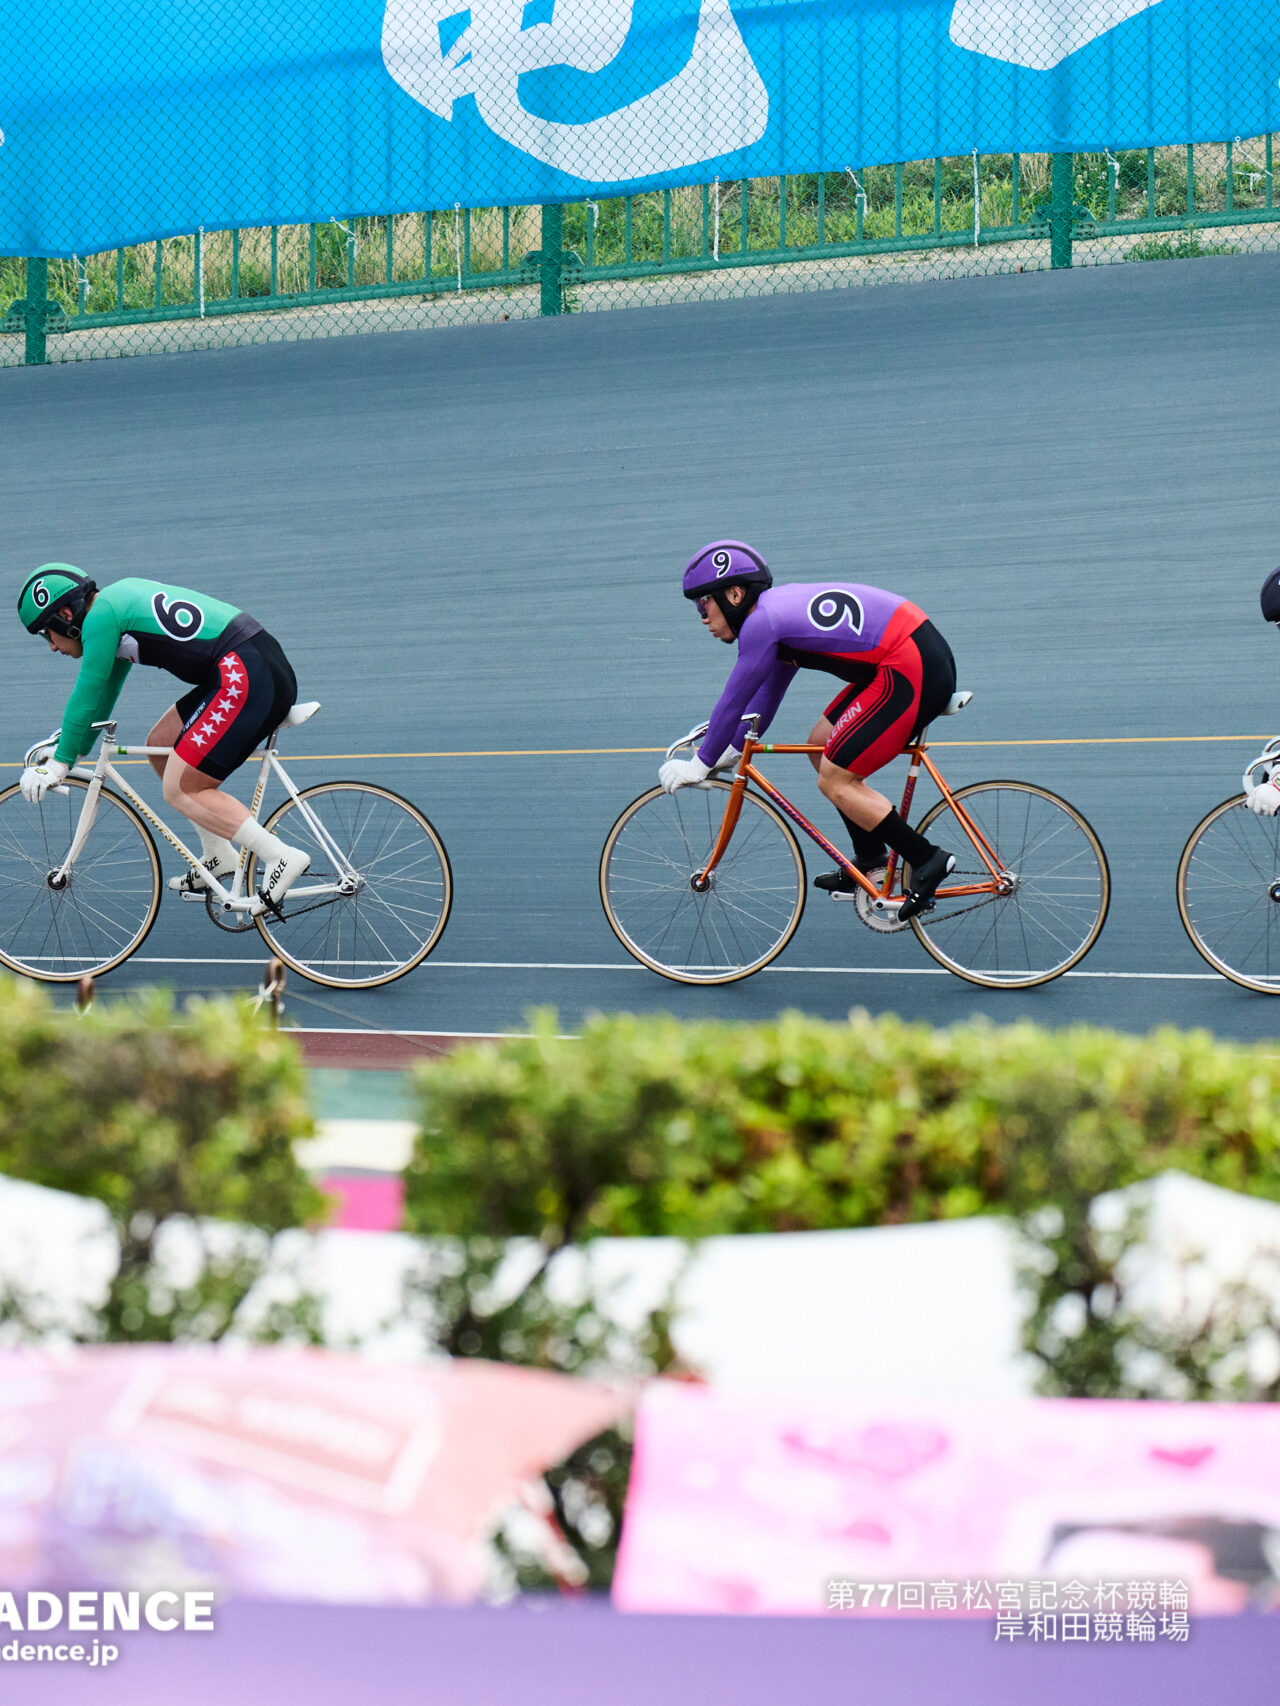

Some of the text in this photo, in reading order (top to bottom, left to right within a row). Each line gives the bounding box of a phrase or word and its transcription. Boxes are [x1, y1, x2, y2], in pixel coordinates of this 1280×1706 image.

[712, 550, 731, 578] 9
[32, 579, 50, 609] 6
[807, 589, 864, 636] 9
[151, 591, 204, 641] 6
